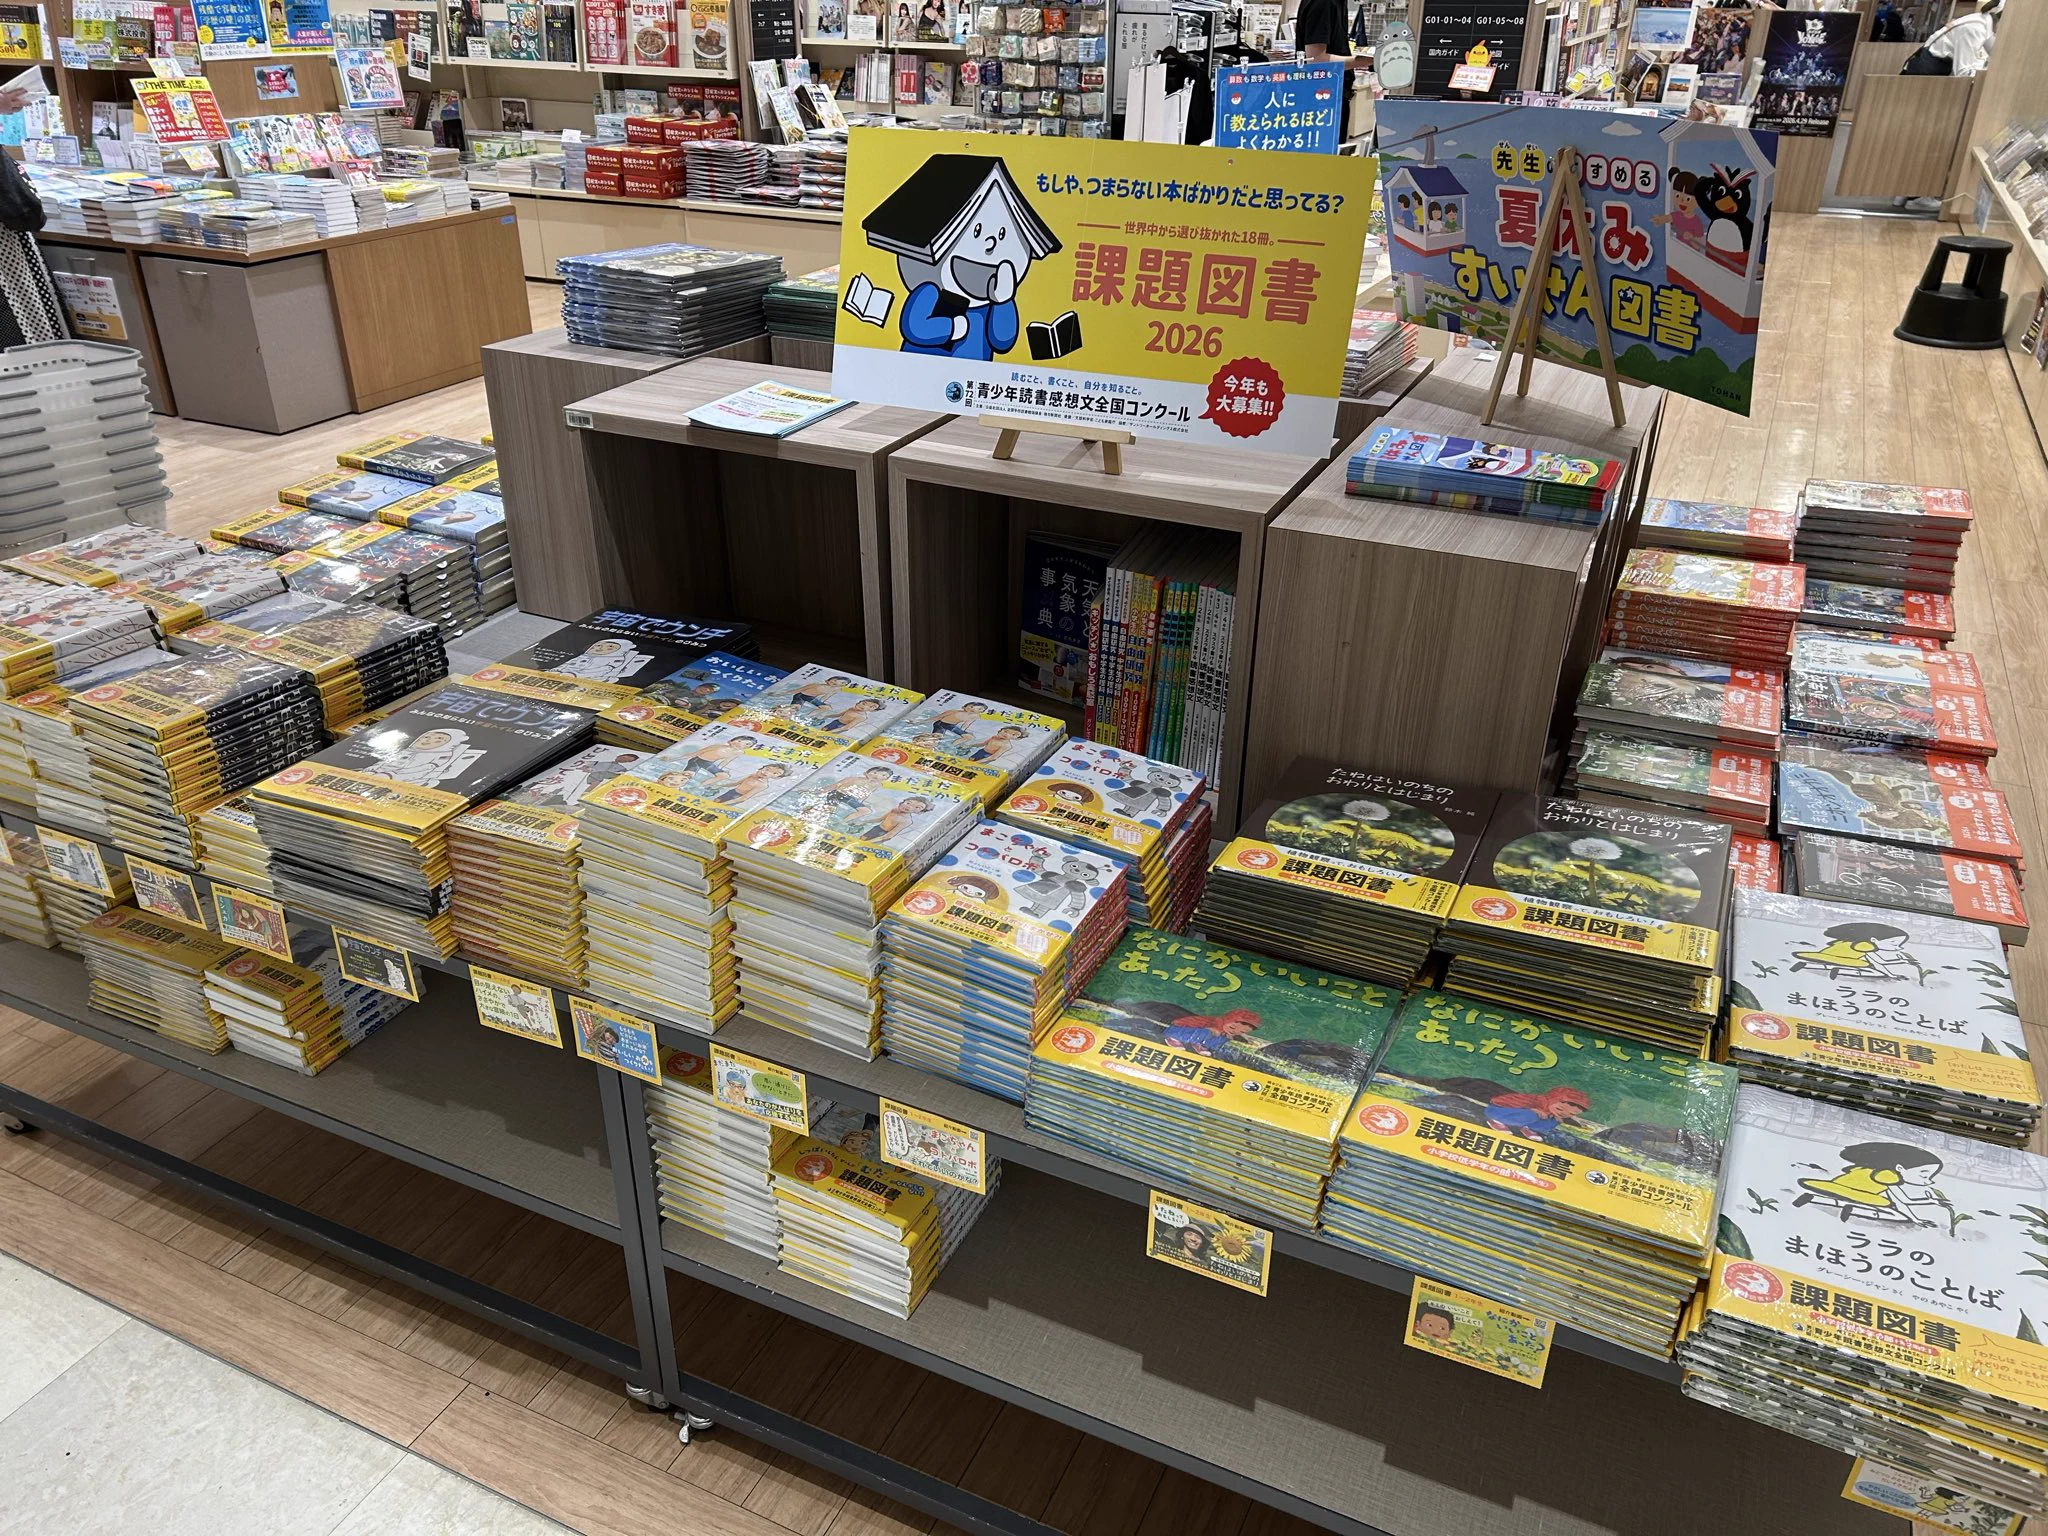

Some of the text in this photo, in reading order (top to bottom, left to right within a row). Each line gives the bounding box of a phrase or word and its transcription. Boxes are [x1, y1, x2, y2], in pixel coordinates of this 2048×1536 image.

[644, 5, 665, 16] すき家
[1264, 91, 1295, 109] 人に
[1223, 108, 1334, 132] 「教えられるほど」
[1808, 118, 1829, 126] Release
[1036, 172, 1345, 214] もしや、つまらない本ばかりだと思ってる?
[1124, 221, 1275, 248] 世界中から選び抜かれた18冊。
[1498, 188, 1653, 270] 夏休み
[1072, 242, 1323, 325] 課題図書
[1449, 248, 1702, 352] すいせん図書
[1145, 320, 1223, 358] 2026
[1011, 372, 1143, 395] 読むこと、書くこと、自分を知ること。
[1223, 376, 1269, 395] 今年も
[1710, 386, 1742, 401] TOHAN
[977, 383, 1191, 422] 青少年読書感想文全国コンクール
[1216, 395, 1275, 417] 大募集!!
[1059, 572, 1078, 633] 気象の
[594, 610, 733, 641] 宇宙でウンチ
[848, 682, 902, 697] まだまだ
[865, 691, 910, 706] ここから
[986, 708, 1040, 722] まだまだ
[1003, 718, 1051, 733] ここから
[752, 743, 811, 757] まだまだ
[771, 754, 820, 770] ここから
[1071, 744, 1135, 769] まこちゃん
[890, 774, 950, 789] まだまだ
[911, 786, 962, 804] ここから
[1326, 775, 1449, 805] おわりとはじまり
[1332, 767, 1455, 796] たねはいのちの
[1543, 811, 1680, 842] おわりとはじまり
[1546, 801, 1684, 830] たねはいのちの
[1972, 810, 1988, 842] 先生のすすめる
[1982, 792, 2011, 845] 夏休みすいせん図書
[965, 842, 1040, 871] コトバロボ
[980, 828, 1051, 858] まこちゃん
[1805, 833, 1915, 860] 博物館
[1281, 857, 1394, 894] 課題図書
[1839, 873, 1946, 897] の少女
[1987, 864, 2015, 915] 夏休みすいせん図書
[1981, 881, 1997, 912] 先生のすすめる
[946, 906, 1014, 934] 課題図書
[1523, 906, 1650, 943] 課題図書
[1118, 951, 1242, 999] あった?
[1131, 930, 1389, 1008] なにかいいこと
[474, 979, 511, 996] 目の見えない
[1836, 985, 1910, 1008] ララの
[1787, 992, 1968, 1036] まほうのことば
[1414, 1018, 1560, 1075] あった?
[1796, 1023, 1937, 1065] 課題図書
[1098, 1036, 1237, 1090] 課題図書
[930, 1129, 976, 1153] まこちゃん
[1414, 1117, 1575, 1181] 課題図書
[839, 1169, 902, 1201] 課題図書
[1619, 1185, 1693, 1212] 全国コンクール
[1846, 1231, 1935, 1266] ララの
[1785, 1235, 2005, 1311] まほうのことば
[1420, 1282, 1452, 1297] 課題図書
[1790, 1280, 1961, 1352] 課題図書
